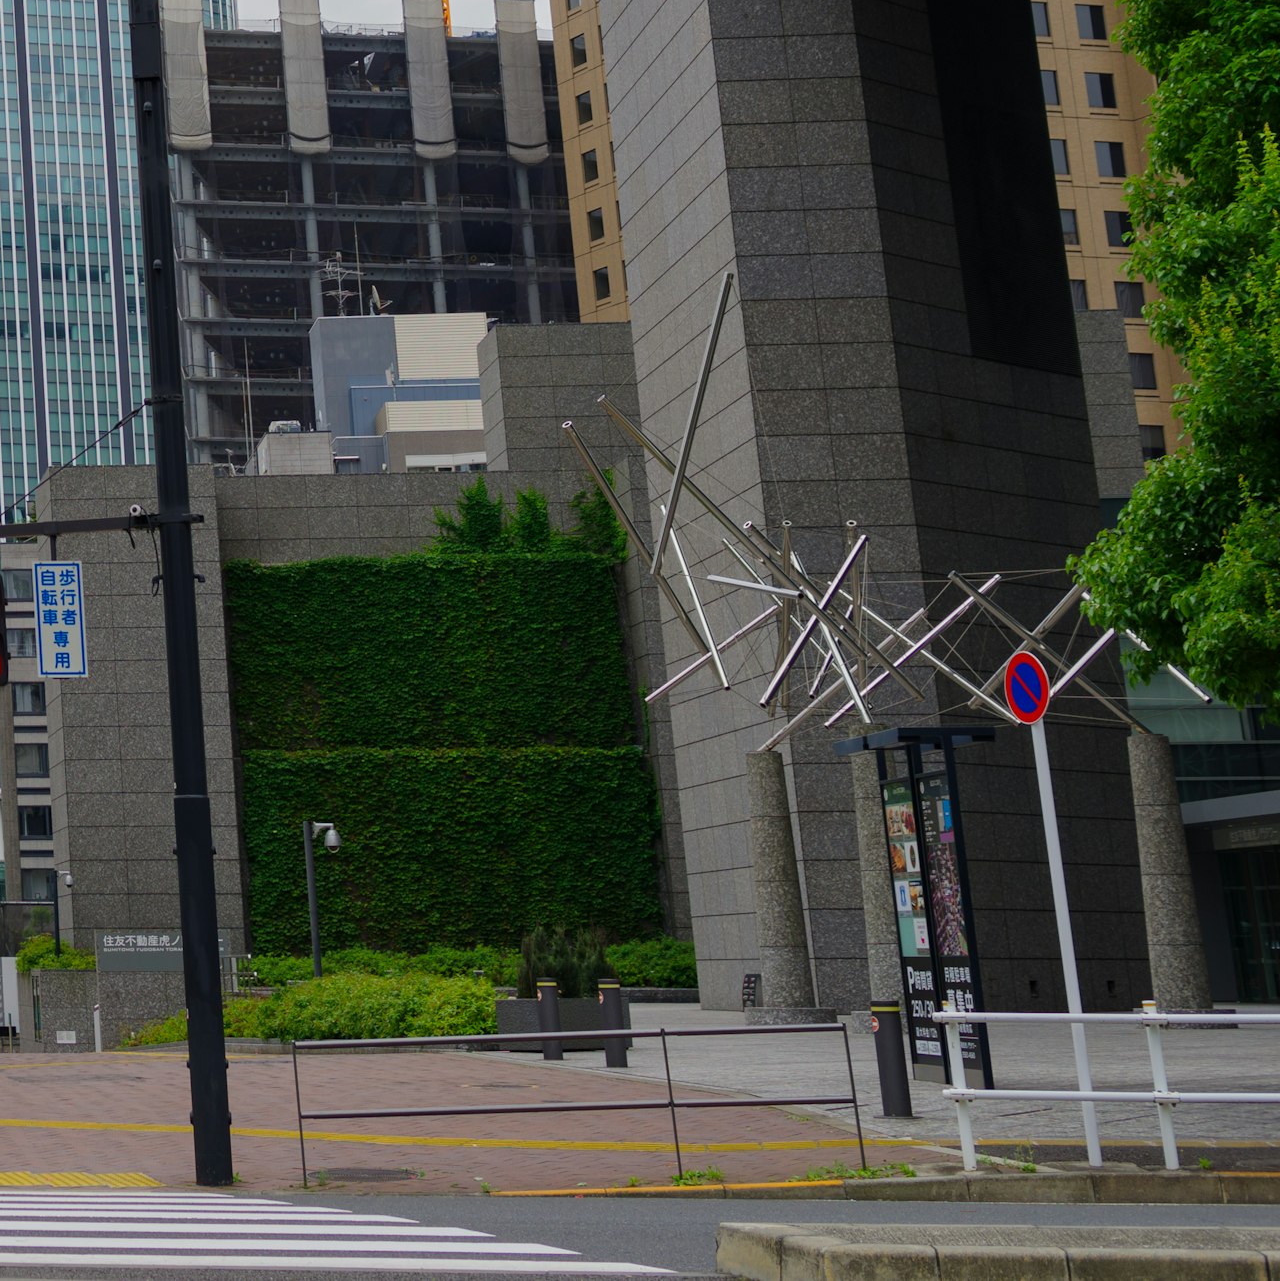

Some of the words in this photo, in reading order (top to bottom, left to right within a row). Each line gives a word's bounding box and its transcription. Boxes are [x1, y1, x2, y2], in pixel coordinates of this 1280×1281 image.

[41, 569, 59, 626] 自転車
[59, 569, 77, 626] 歩行者
[53, 630, 71, 669] 専用
